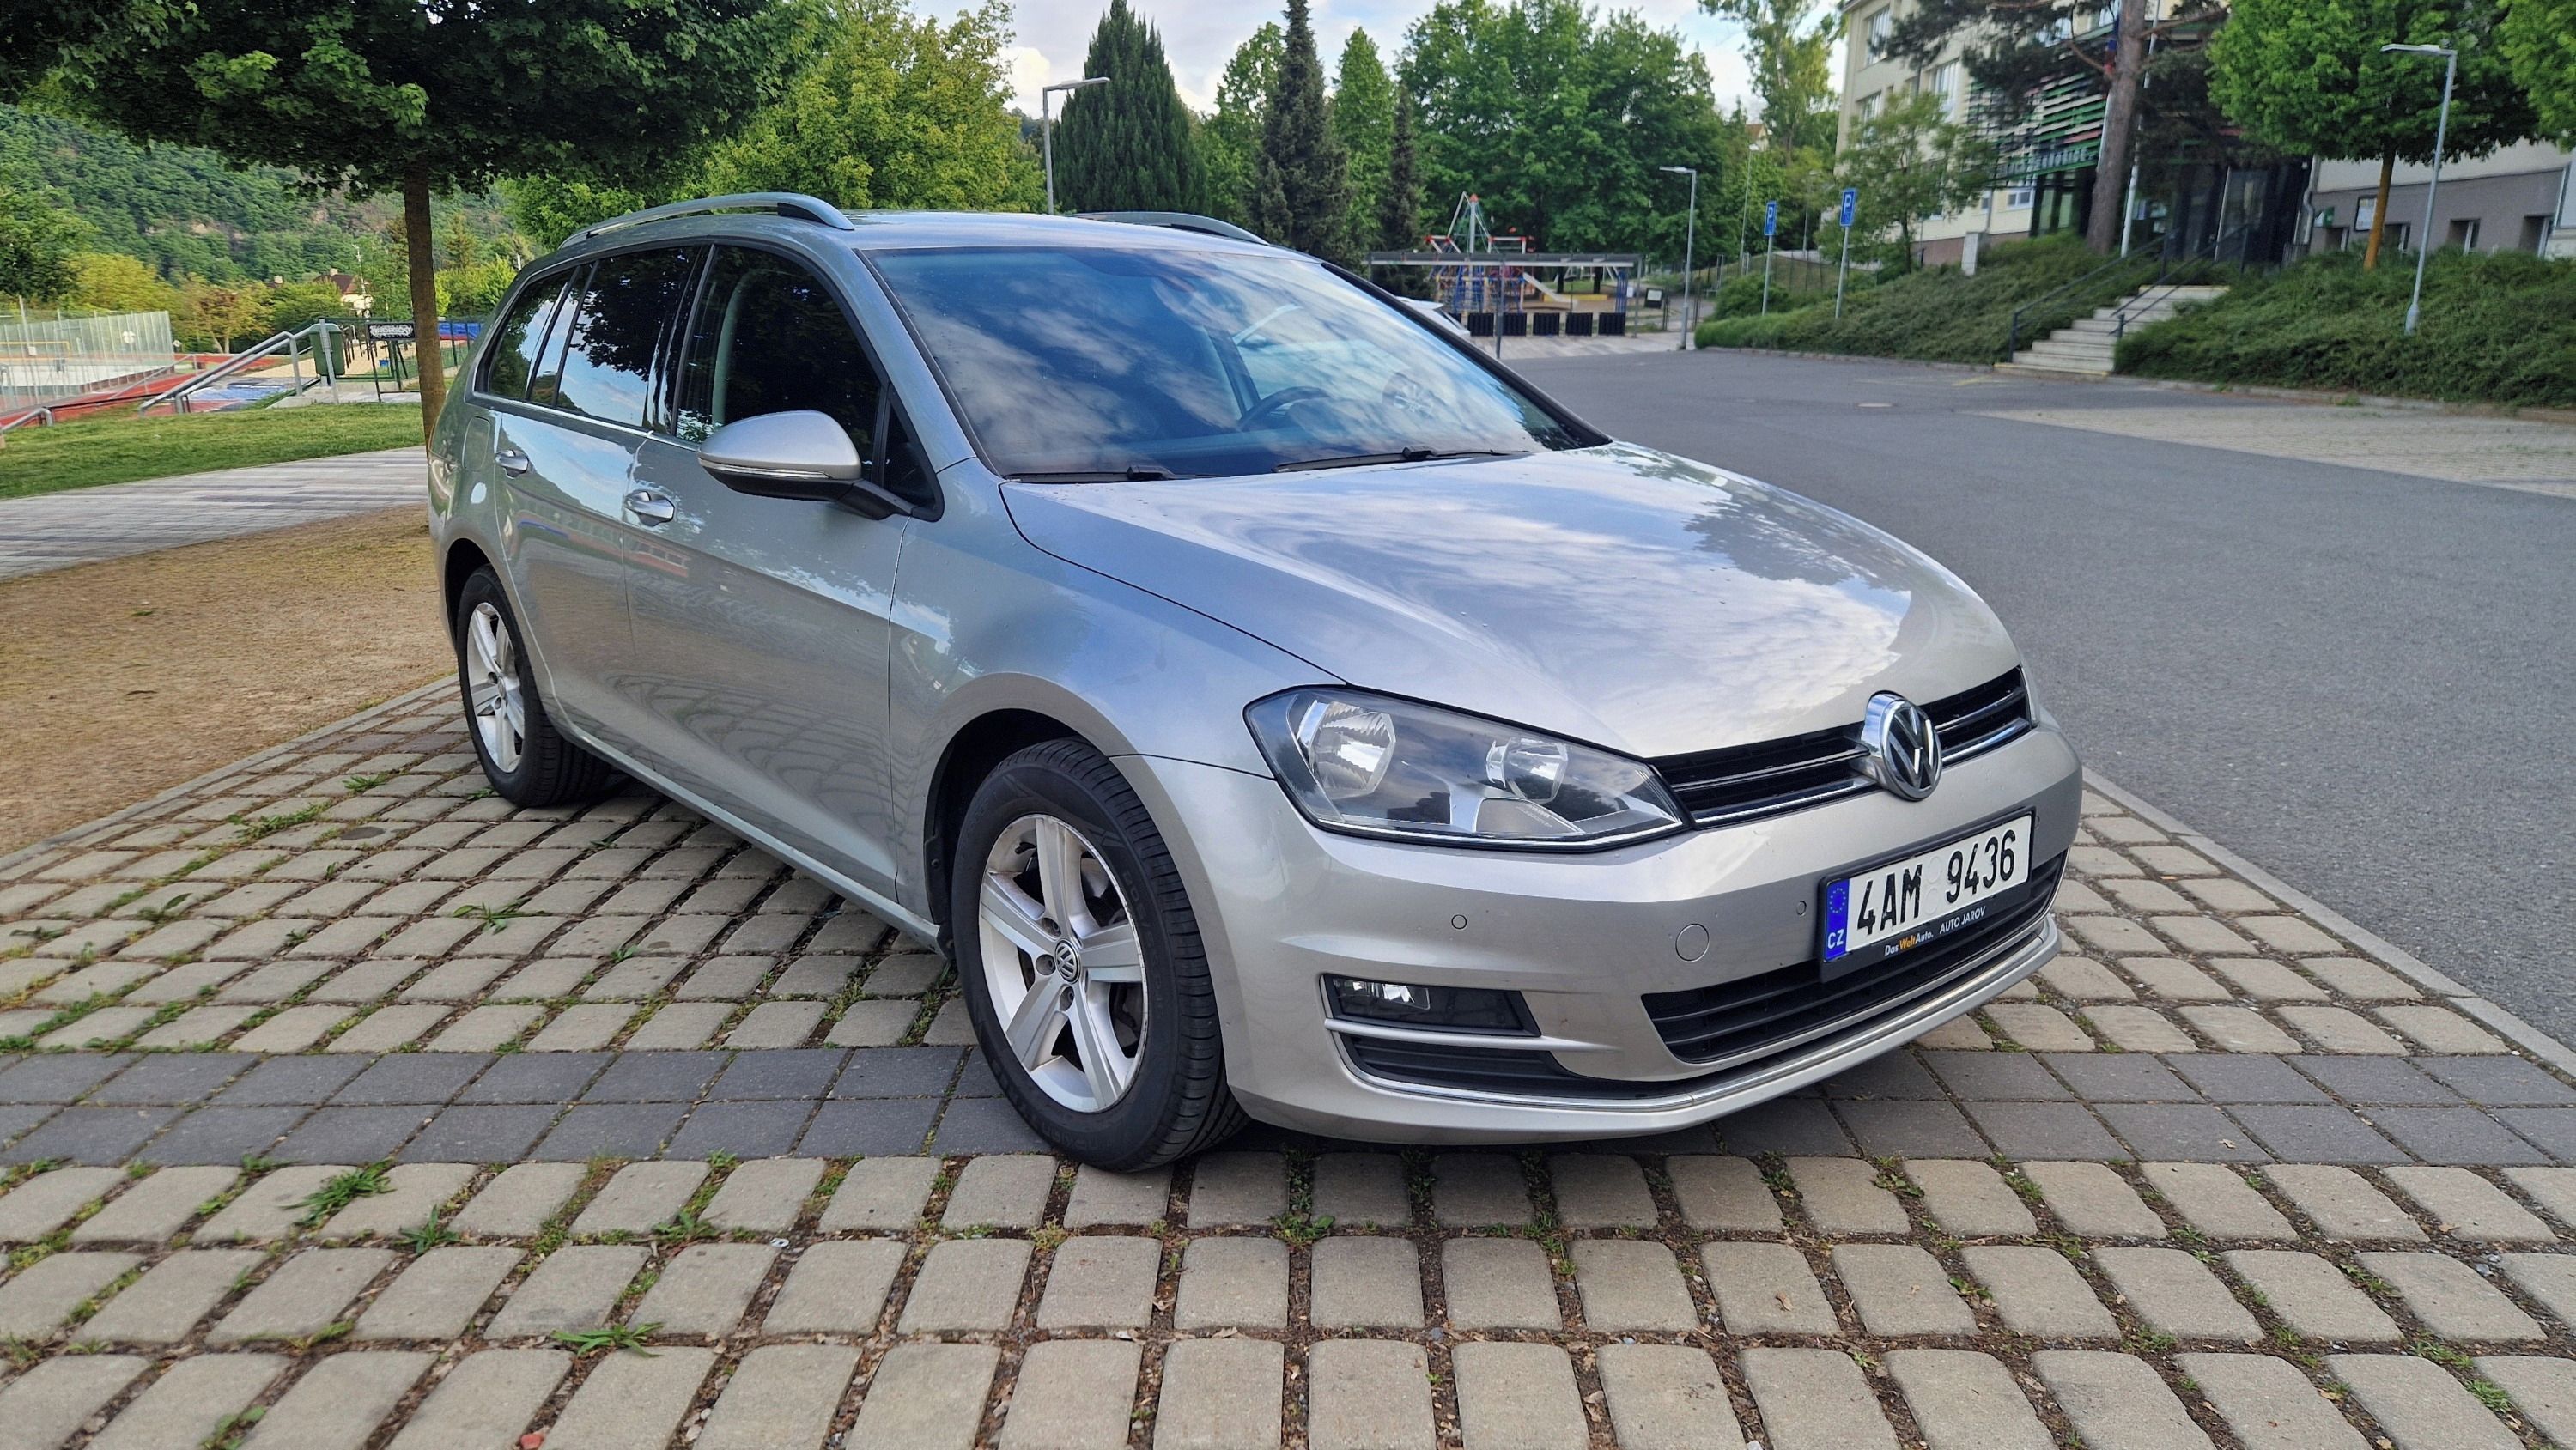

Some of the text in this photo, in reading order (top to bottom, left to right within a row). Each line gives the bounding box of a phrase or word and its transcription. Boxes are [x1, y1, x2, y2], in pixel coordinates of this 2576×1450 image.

[1844, 194, 1852, 214] P
[1856, 829, 2016, 936] 4AM 9436
[1827, 928, 1844, 949] CZ
[1884, 944, 1899, 956] Das
[1939, 917, 1961, 935] AUTO
[1961, 906, 1986, 925] JAROV
